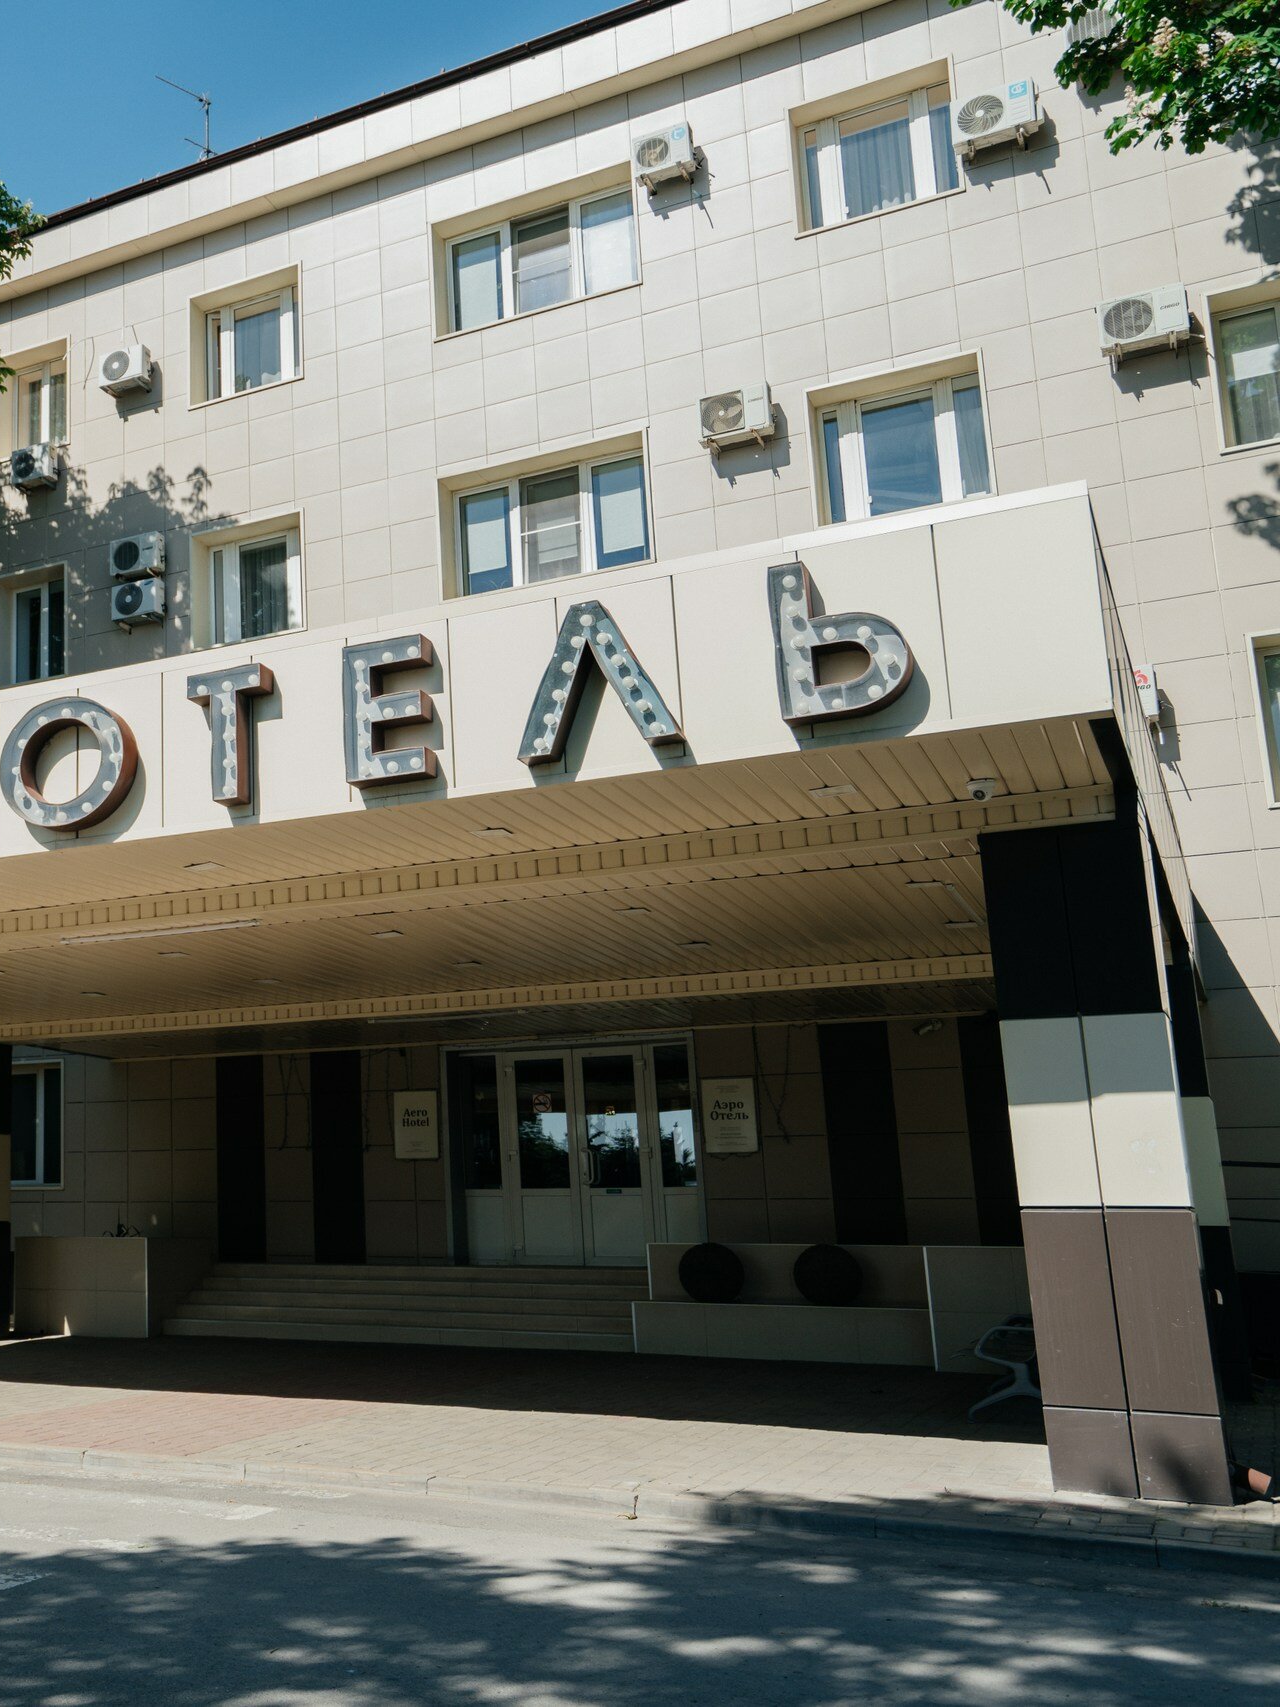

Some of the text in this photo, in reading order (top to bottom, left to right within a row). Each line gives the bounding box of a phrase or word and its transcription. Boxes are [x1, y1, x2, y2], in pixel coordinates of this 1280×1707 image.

[0, 561, 913, 832] ОТЕЛЬ
[713, 1100, 744, 1111] Аэро
[403, 1108, 428, 1117] Aero
[710, 1111, 749, 1121] Отель
[402, 1117, 430, 1127] Hotel
